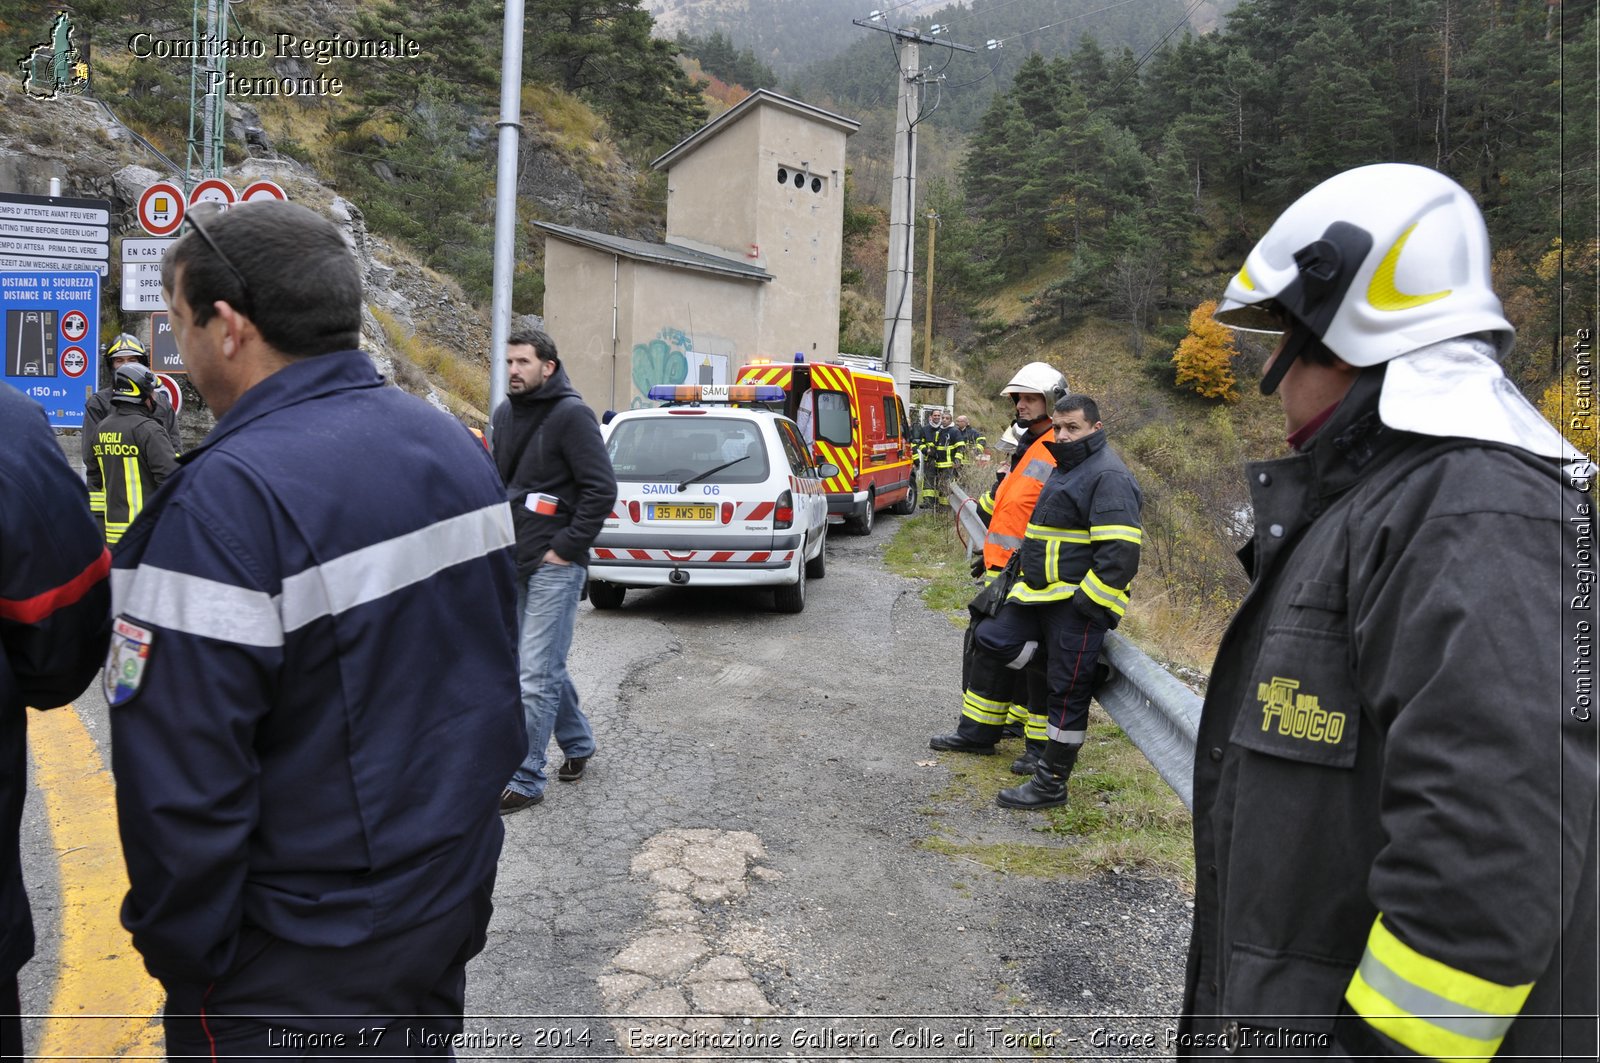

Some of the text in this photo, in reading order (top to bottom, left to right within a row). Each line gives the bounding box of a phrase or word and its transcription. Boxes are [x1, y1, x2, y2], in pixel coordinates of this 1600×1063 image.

[24, 208, 49, 216] ATTENTE
[51, 210, 68, 218] AVANT
[36, 226, 58, 235] BEFORE
[60, 228, 80, 236] GREEN
[82, 230, 98, 238] LIGHT
[24, 243, 44, 251] ATTESA
[80, 247, 97, 255] VERDE
[142, 248, 157, 256] CAS
[19, 260, 31, 268] ZUM
[34, 261, 60, 270] WECHSEL
[62, 263, 72, 271] AUF
[2, 278, 94, 287] DISTANZA DI SICUREZZA
[4, 289, 92, 300] DISTANCE DE SÉCURITÉ
[33, 386, 50, 396] 150
[702, 386, 728, 396] SAMU
[99, 432, 122, 444] VIGILI
[105, 444, 140, 456] FUOCO
[642, 484, 720, 496] SAMU 06
[657, 508, 713, 520] 35 AWS 06
[1261, 676, 1346, 744] FUOCO
